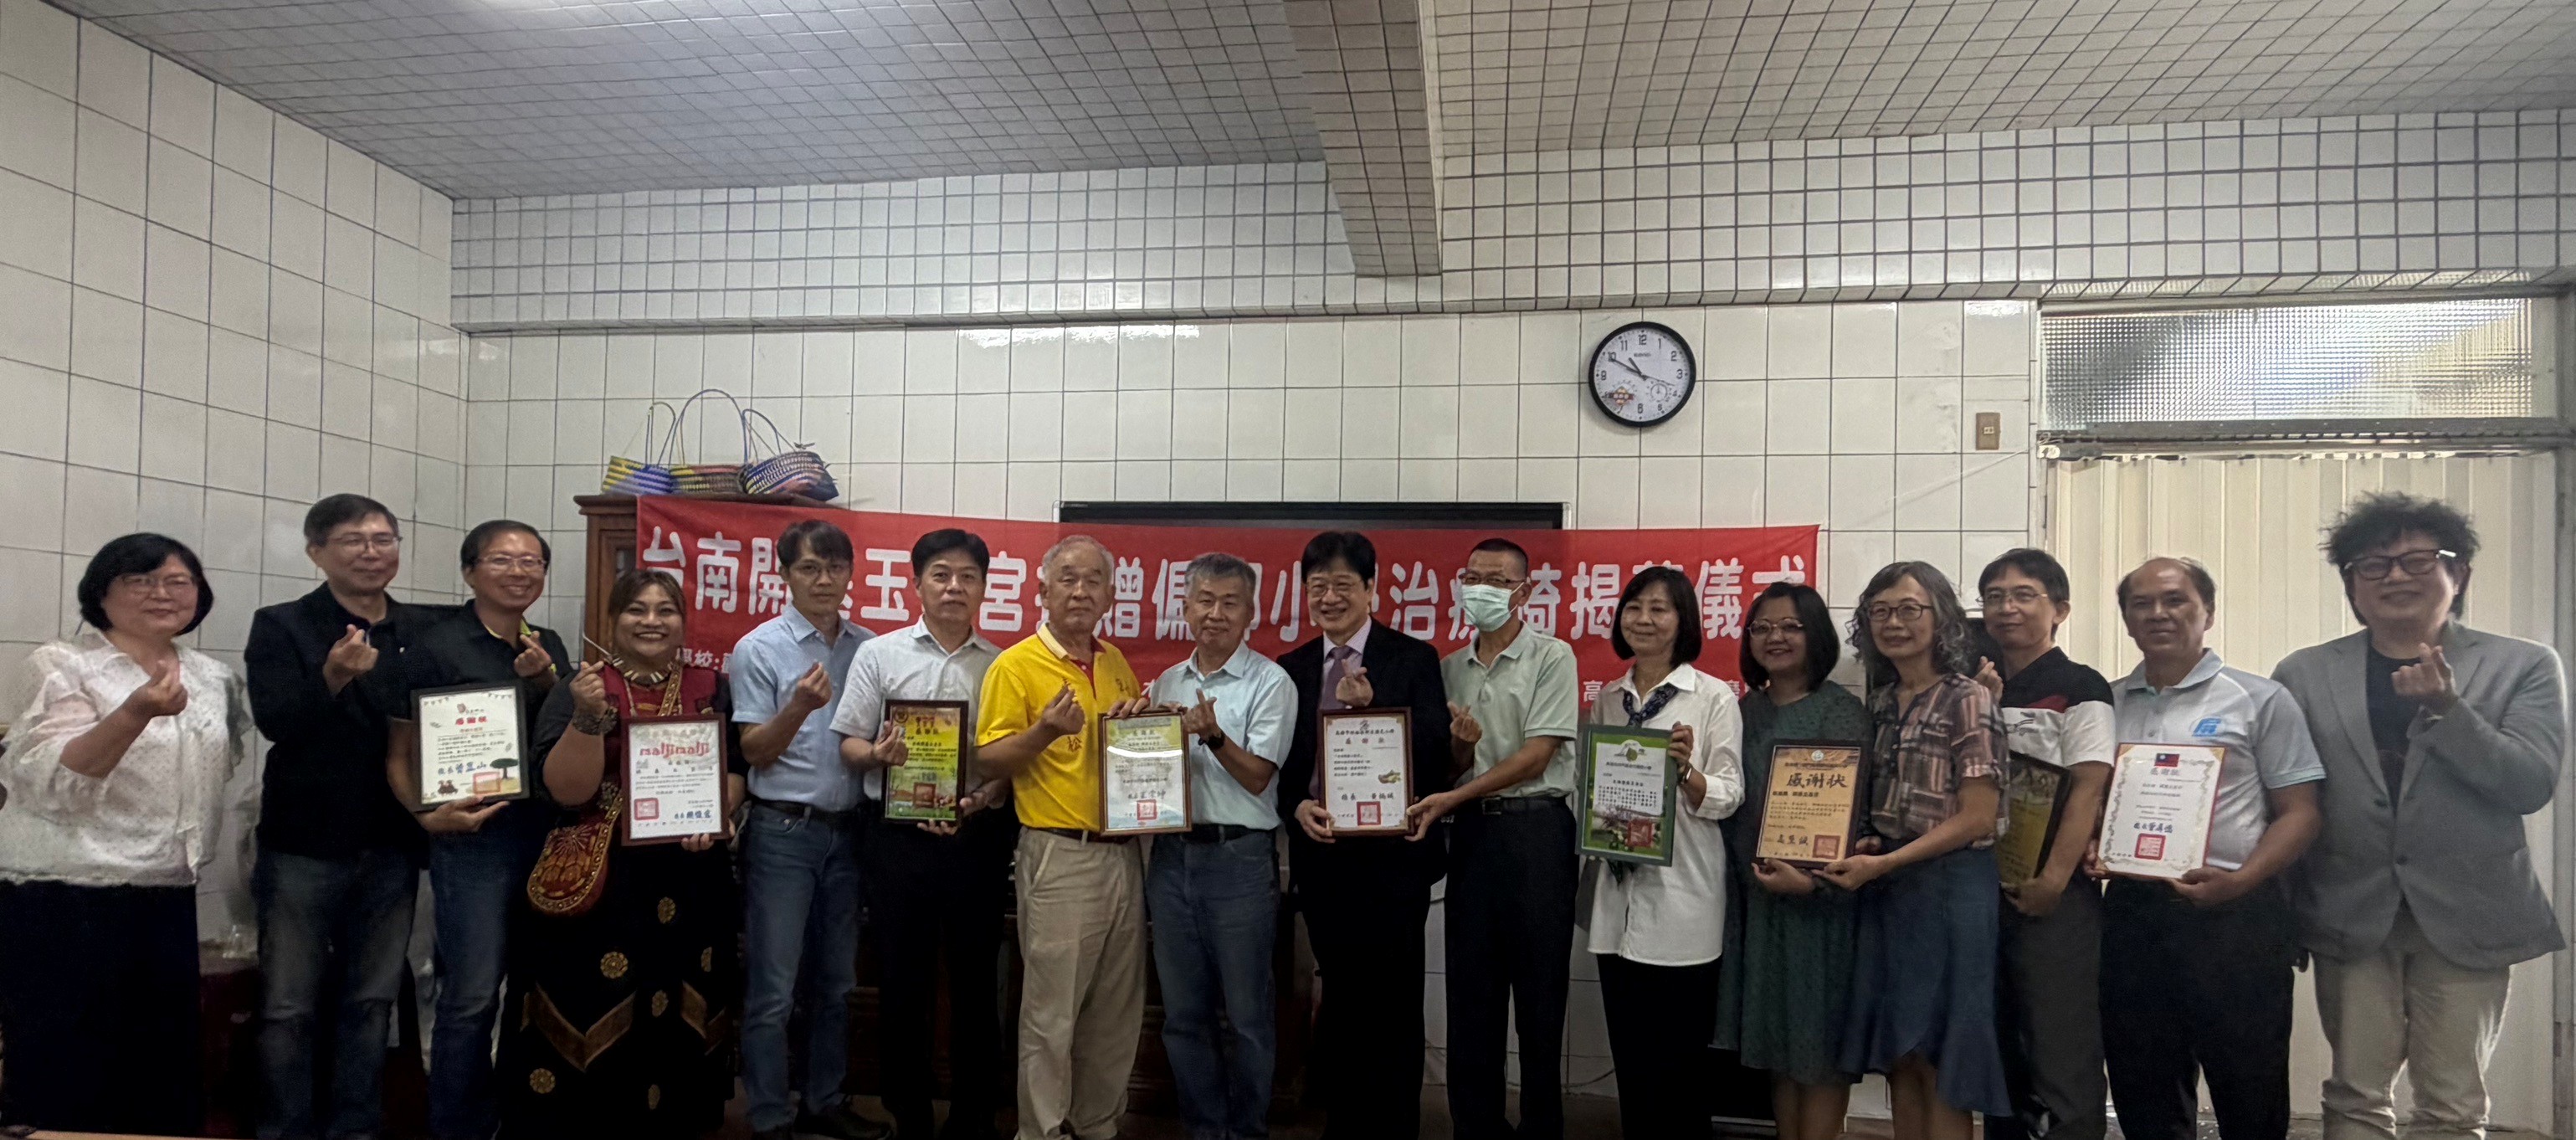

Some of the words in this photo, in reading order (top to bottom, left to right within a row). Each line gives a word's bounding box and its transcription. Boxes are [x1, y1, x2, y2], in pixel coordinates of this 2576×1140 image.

[1638, 334, 1647, 346] 12
[1658, 338, 1661, 350] 1
[1620, 340, 1629, 352] 11
[1670, 351, 1677, 362] 2
[1676, 369, 1683, 380] 3
[1637, 403, 1644, 414] 6
